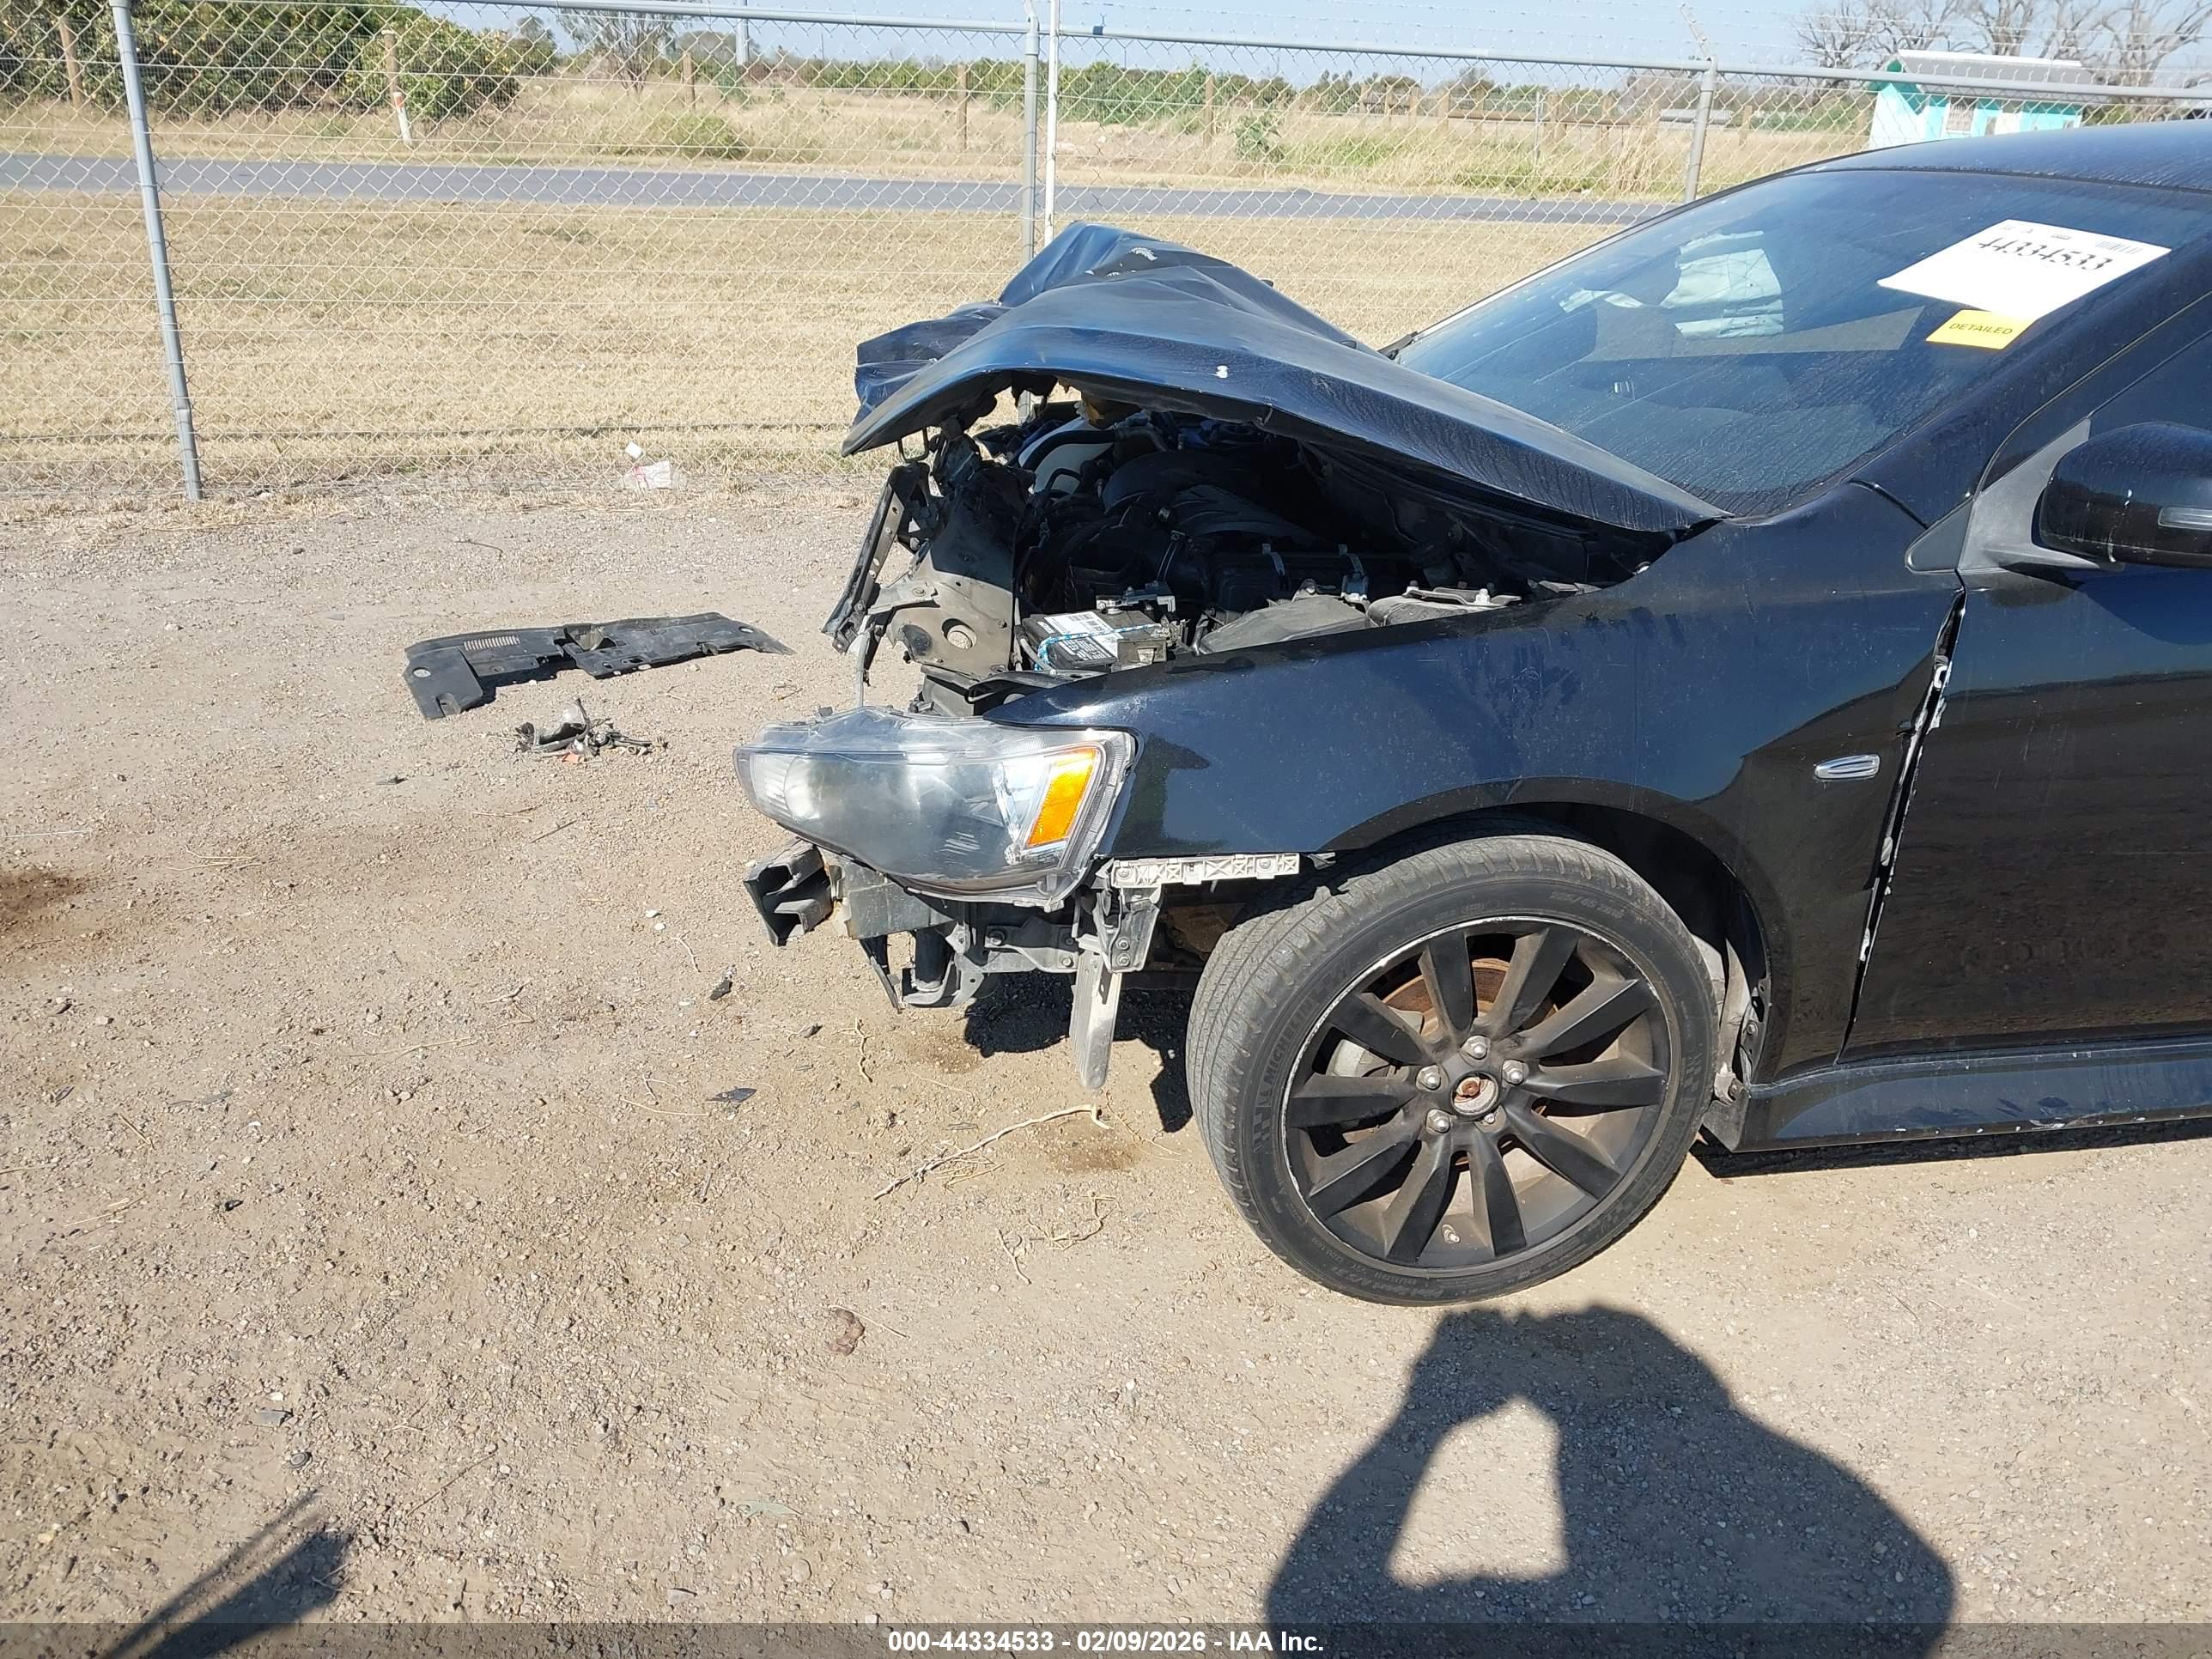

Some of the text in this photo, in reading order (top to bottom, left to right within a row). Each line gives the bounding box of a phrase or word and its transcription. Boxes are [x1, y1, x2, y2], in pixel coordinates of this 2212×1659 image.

[1978, 237, 2113, 270] 44334533
[1948, 323, 2014, 335] DETAILED
[1263, 996, 1317, 1086] MICHELIN
